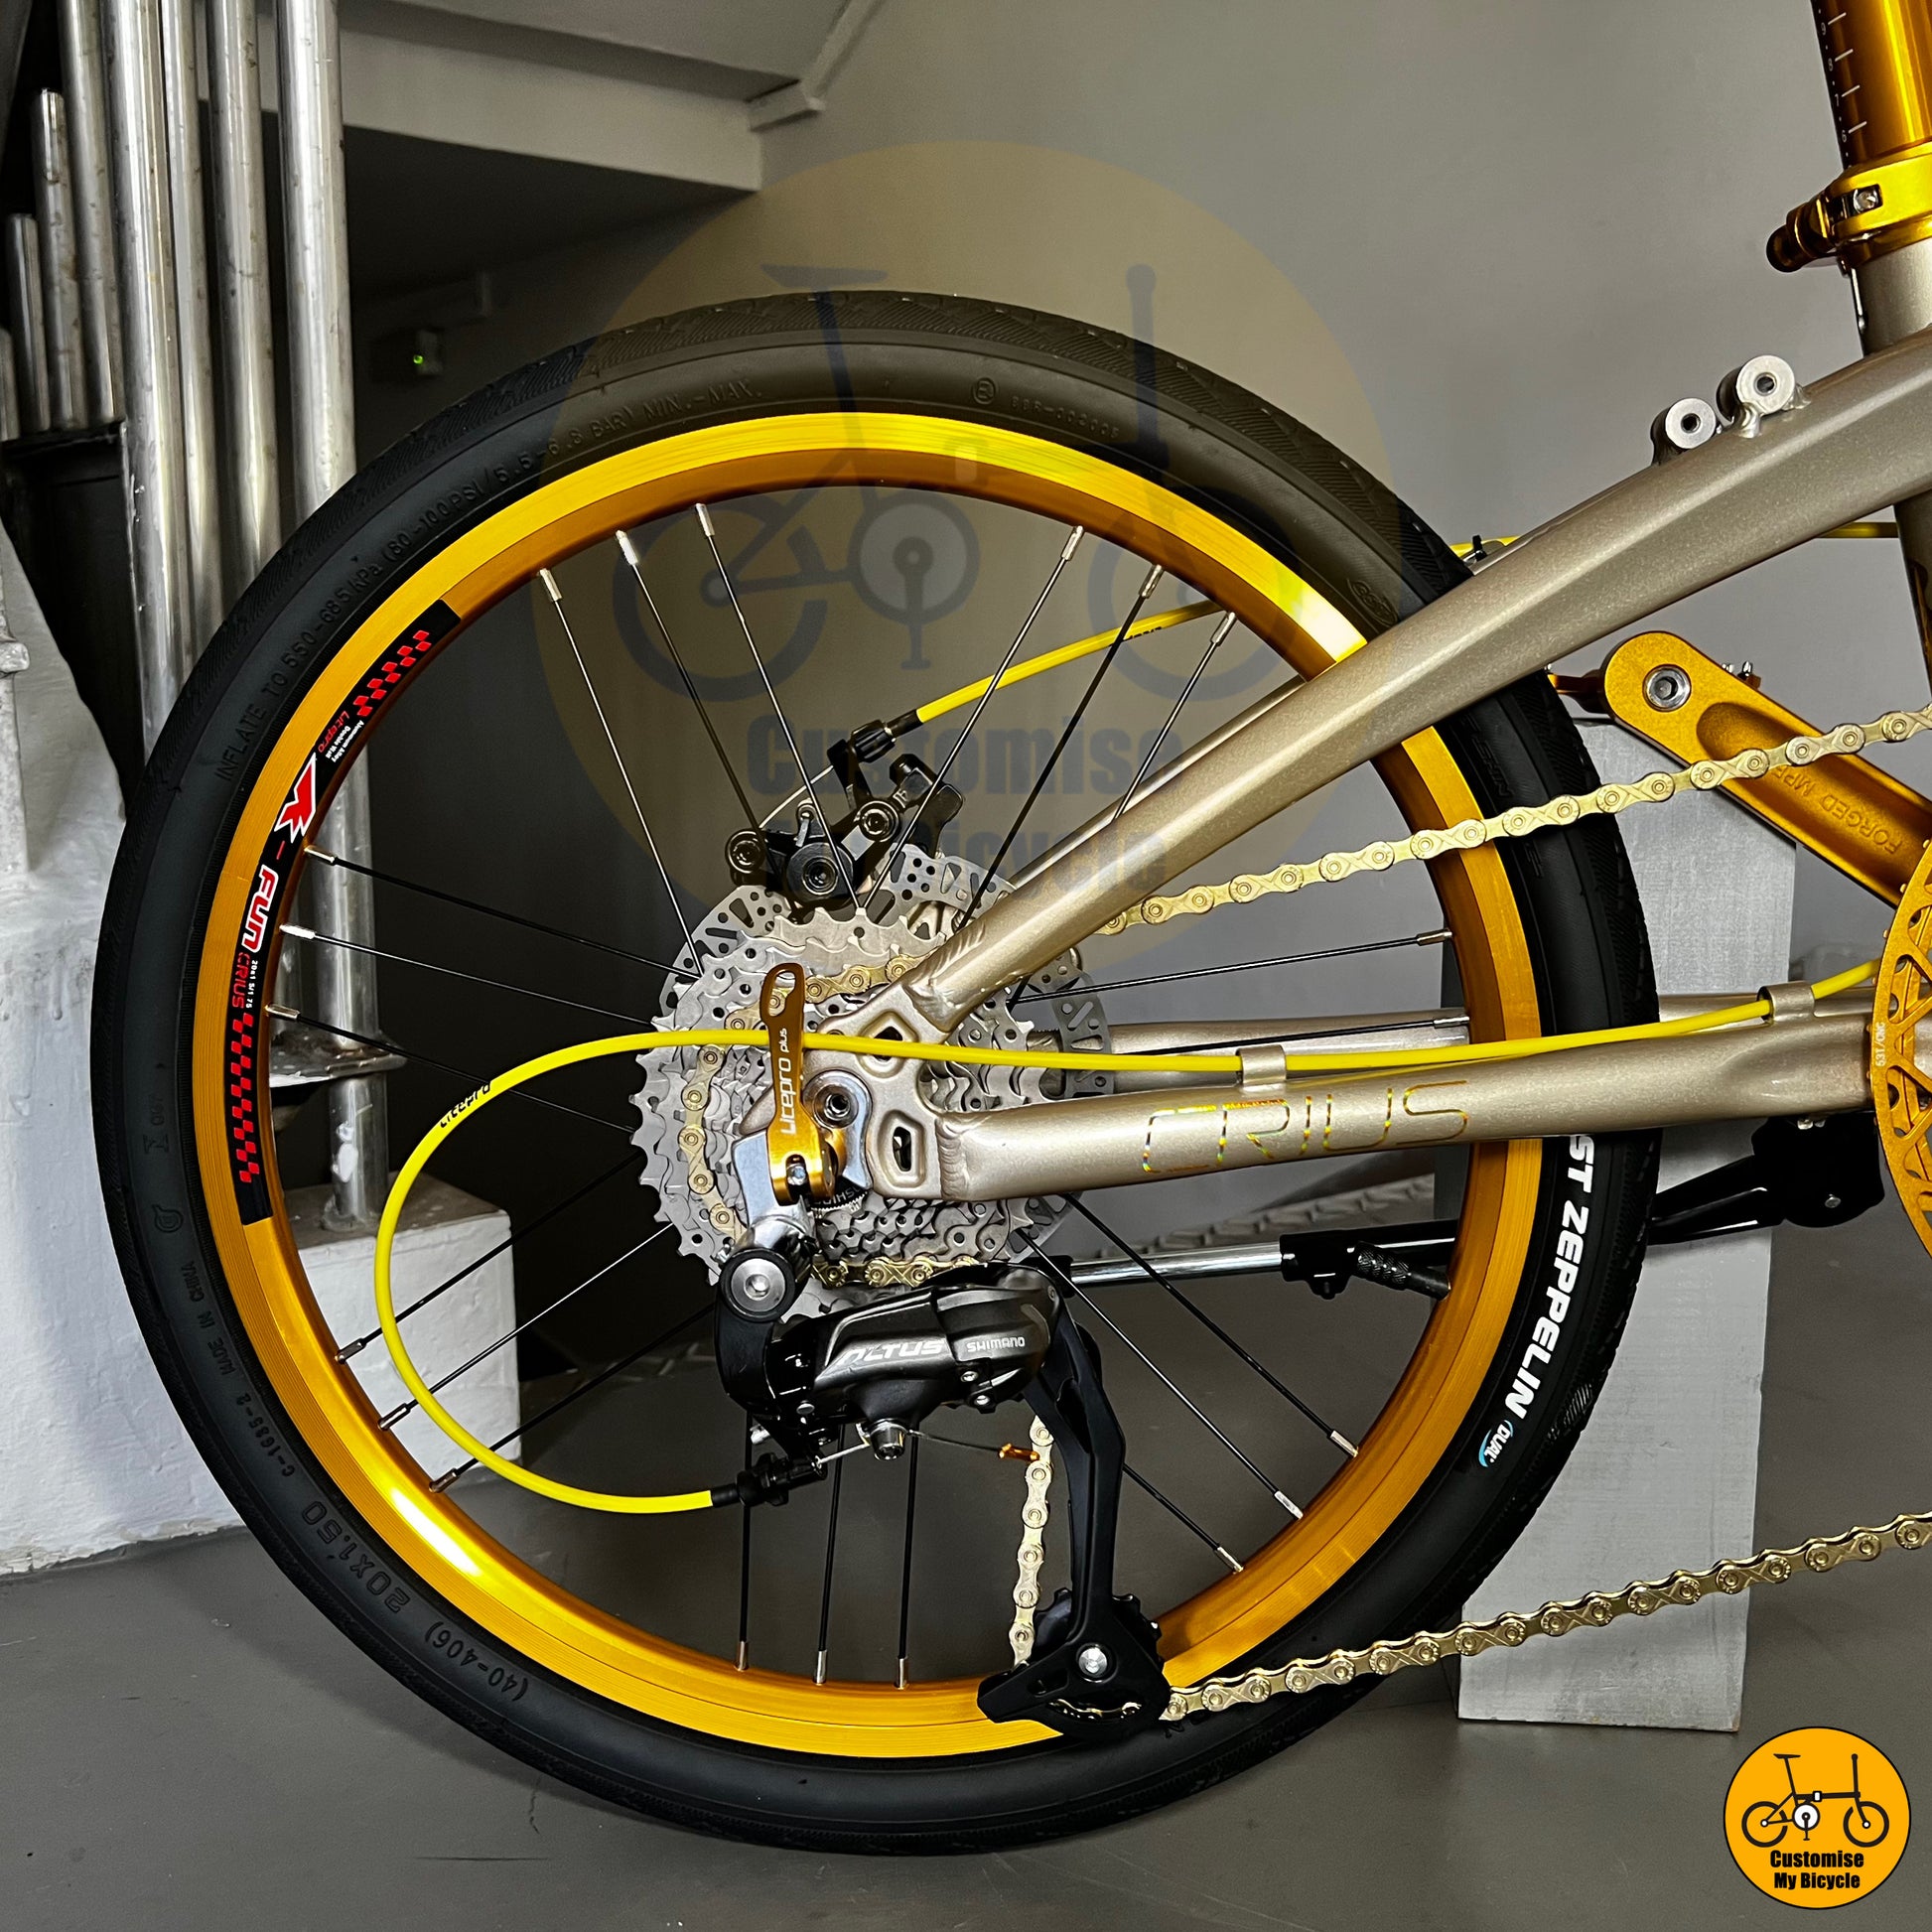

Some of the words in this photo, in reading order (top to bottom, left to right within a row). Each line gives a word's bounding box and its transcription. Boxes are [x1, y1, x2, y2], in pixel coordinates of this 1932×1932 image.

[1820, 22, 1827, 36] 9
[1827, 58, 1834, 71] 8
[1834, 93, 1840, 107] 7
[1841, 129, 1848, 143] 6
[211, 700, 267, 782] INFLATE
[260, 668, 290, 700] TO
[1819, 794, 1903, 855] FORGED
[232, 952, 250, 1009] CRIUS
[779, 1028, 789, 1053] plus
[1142, 1080, 1469, 1173] CRIUS
[179, 1259, 206, 1304] CHINA
[195, 1310, 215, 1330] IN
[1504, 1199, 1589, 1420] ZEPPELIN
[206, 1336, 236, 1377] MADE
[838, 1338, 945, 1365] ALTUS
[966, 1335, 1026, 1353] SHIMANO
[1483, 1424, 1511, 1462] DUAL
[425, 1621, 529, 1701] (40-406)
